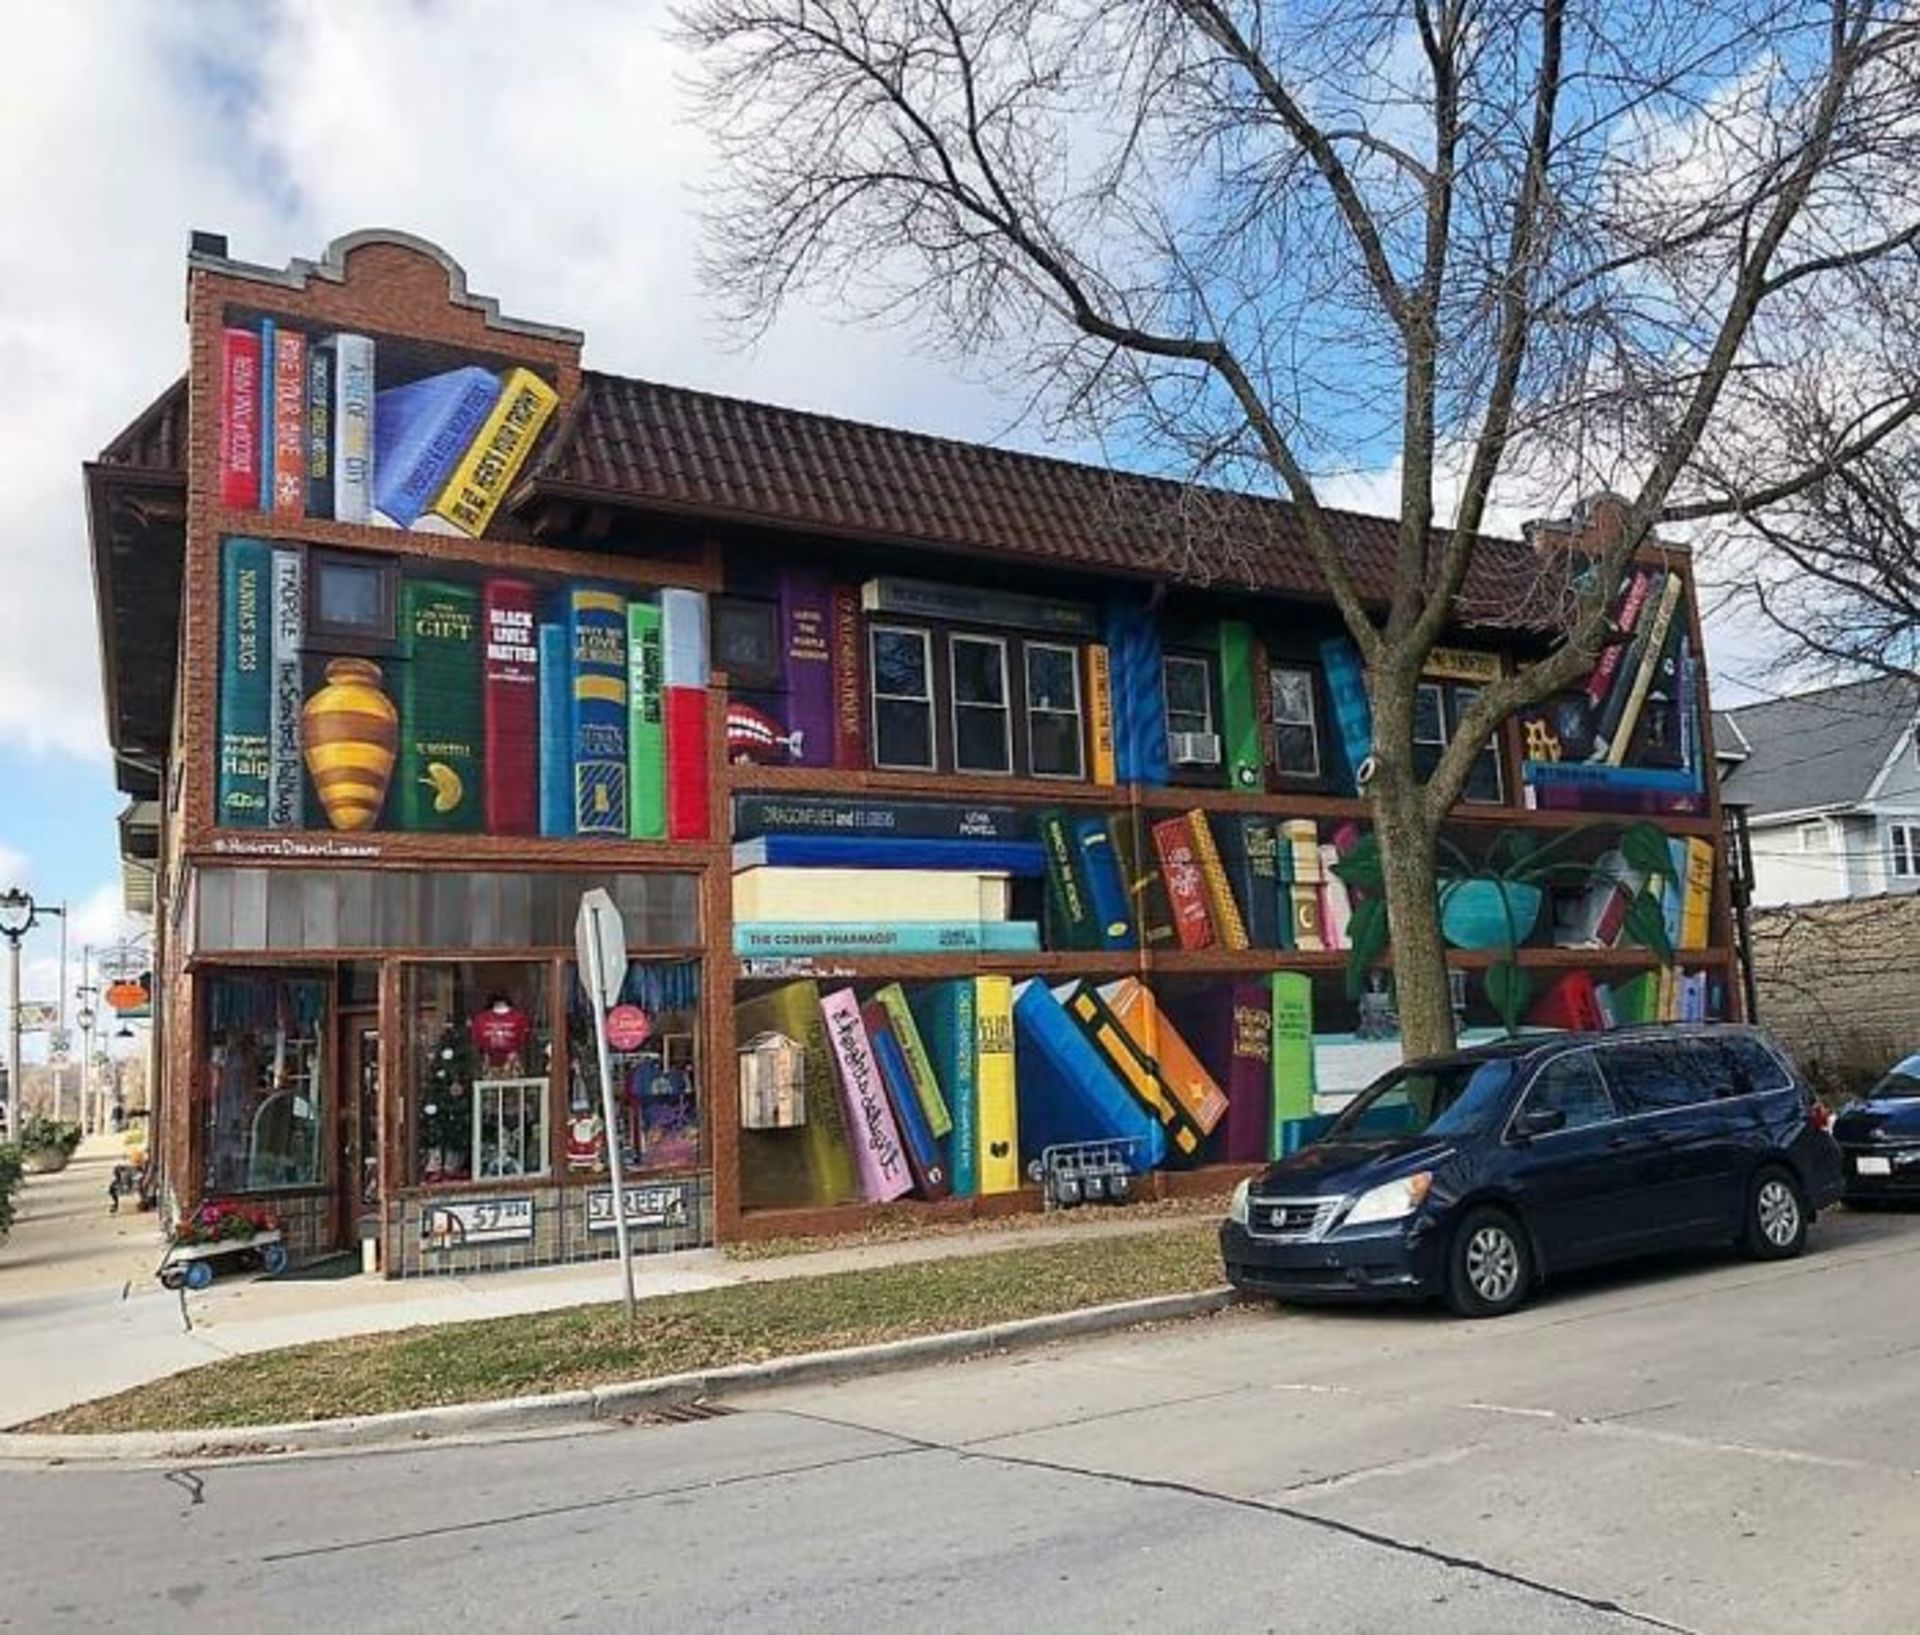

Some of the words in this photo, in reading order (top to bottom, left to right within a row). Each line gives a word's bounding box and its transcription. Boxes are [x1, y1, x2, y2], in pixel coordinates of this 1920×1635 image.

[489, 608, 534, 629] BLACK
[416, 620, 474, 640] GIFT
[493, 626, 530, 645] LIVES
[486, 643, 538, 663] MATTER
[221, 757, 270, 780] Haig
[750, 934, 773, 946] THE
[774, 933, 823, 946] CORNER
[825, 931, 899, 946] PHARMACIST
